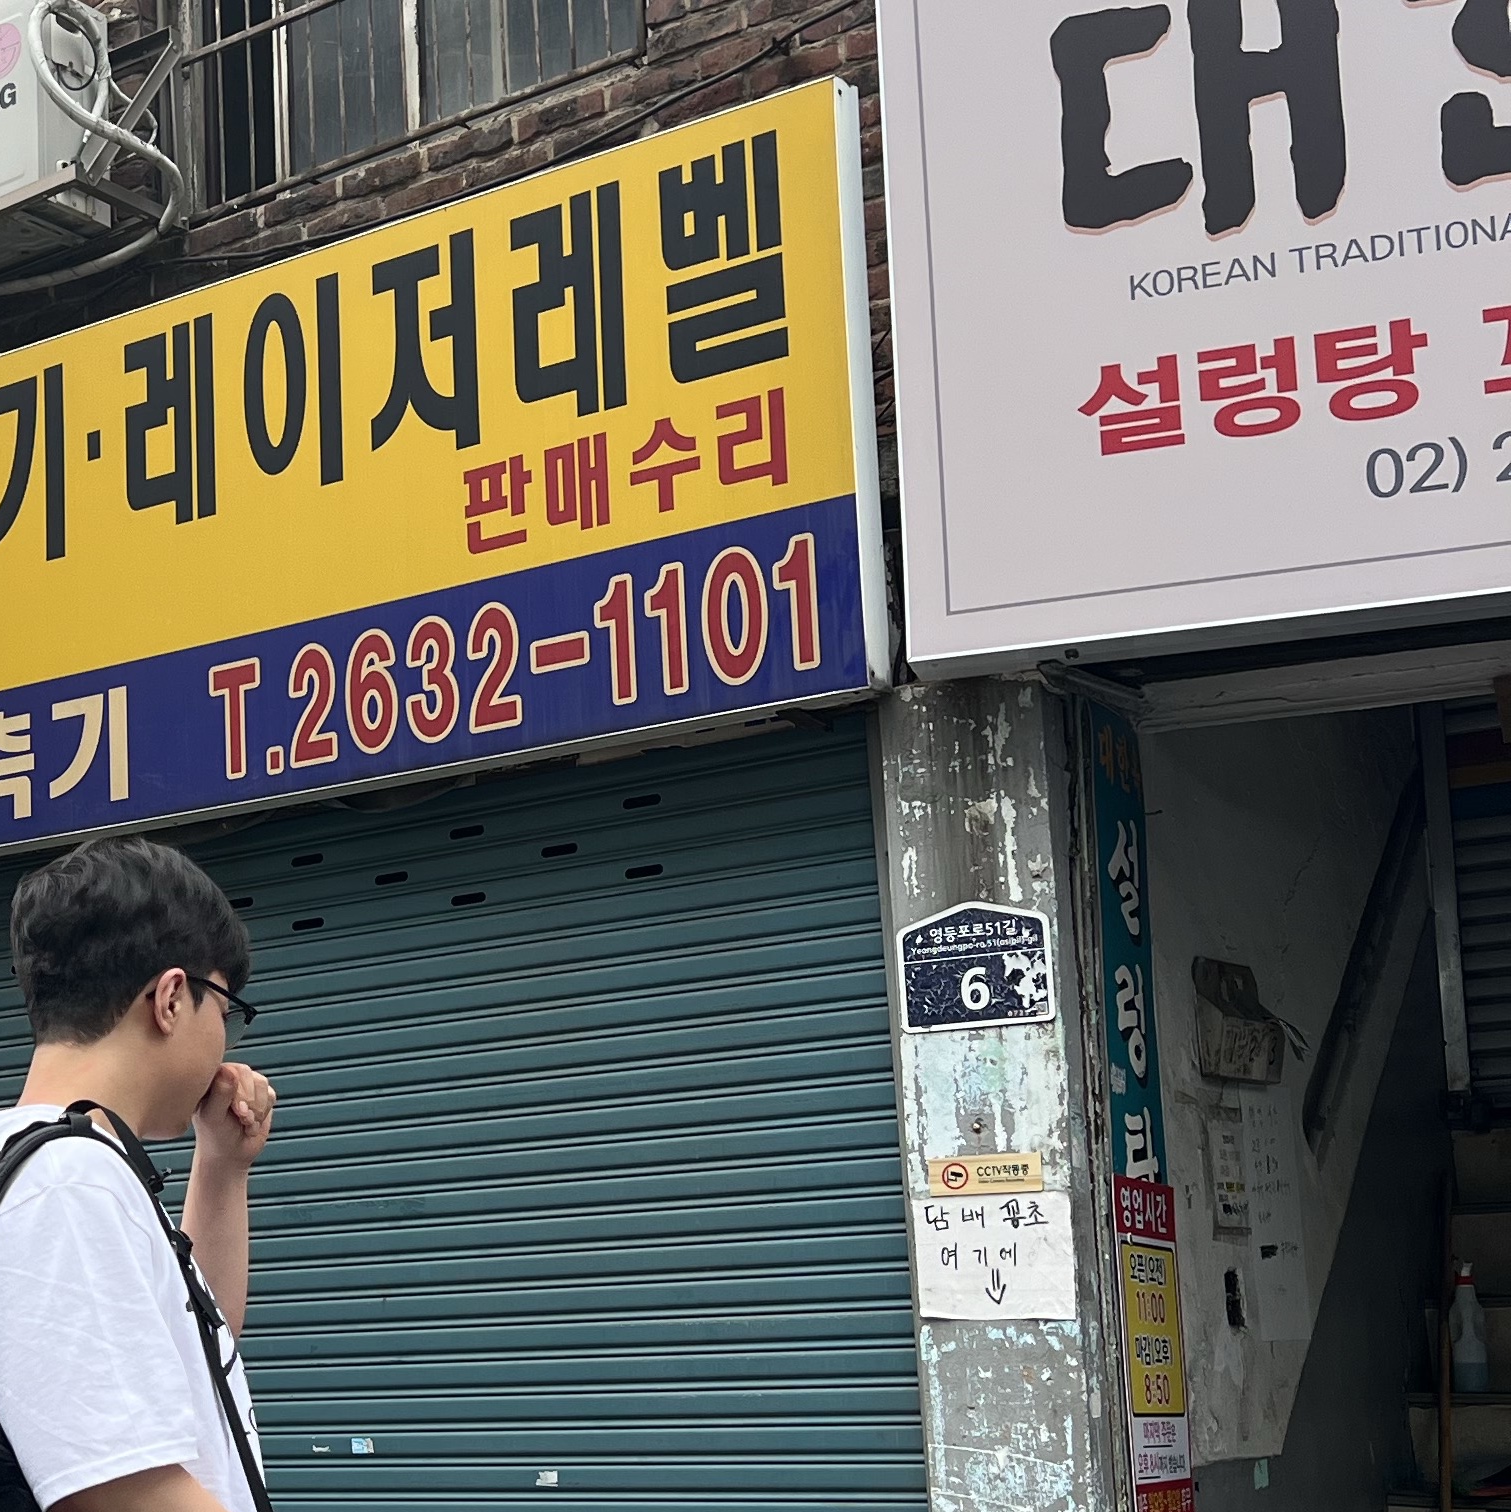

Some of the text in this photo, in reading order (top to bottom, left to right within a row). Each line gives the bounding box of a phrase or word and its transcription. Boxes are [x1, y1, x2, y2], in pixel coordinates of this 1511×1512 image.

[1129, 252, 1277, 301] KOREAN
[1077, 318, 1429, 456] 설렁탕
[463, 386, 789, 555] 판매수리
[1366, 436, 1469, 499] 02)
[208, 532, 823, 782] T.2632-1101
[929, 916, 1019, 944] 영등포로51길
[960, 966, 991, 1011] 6
[1119, 1185, 1168, 1234] 영업시간
[1136, 1290, 1166, 1324] 11:00
[1144, 1373, 1170, 1405] 8:50
